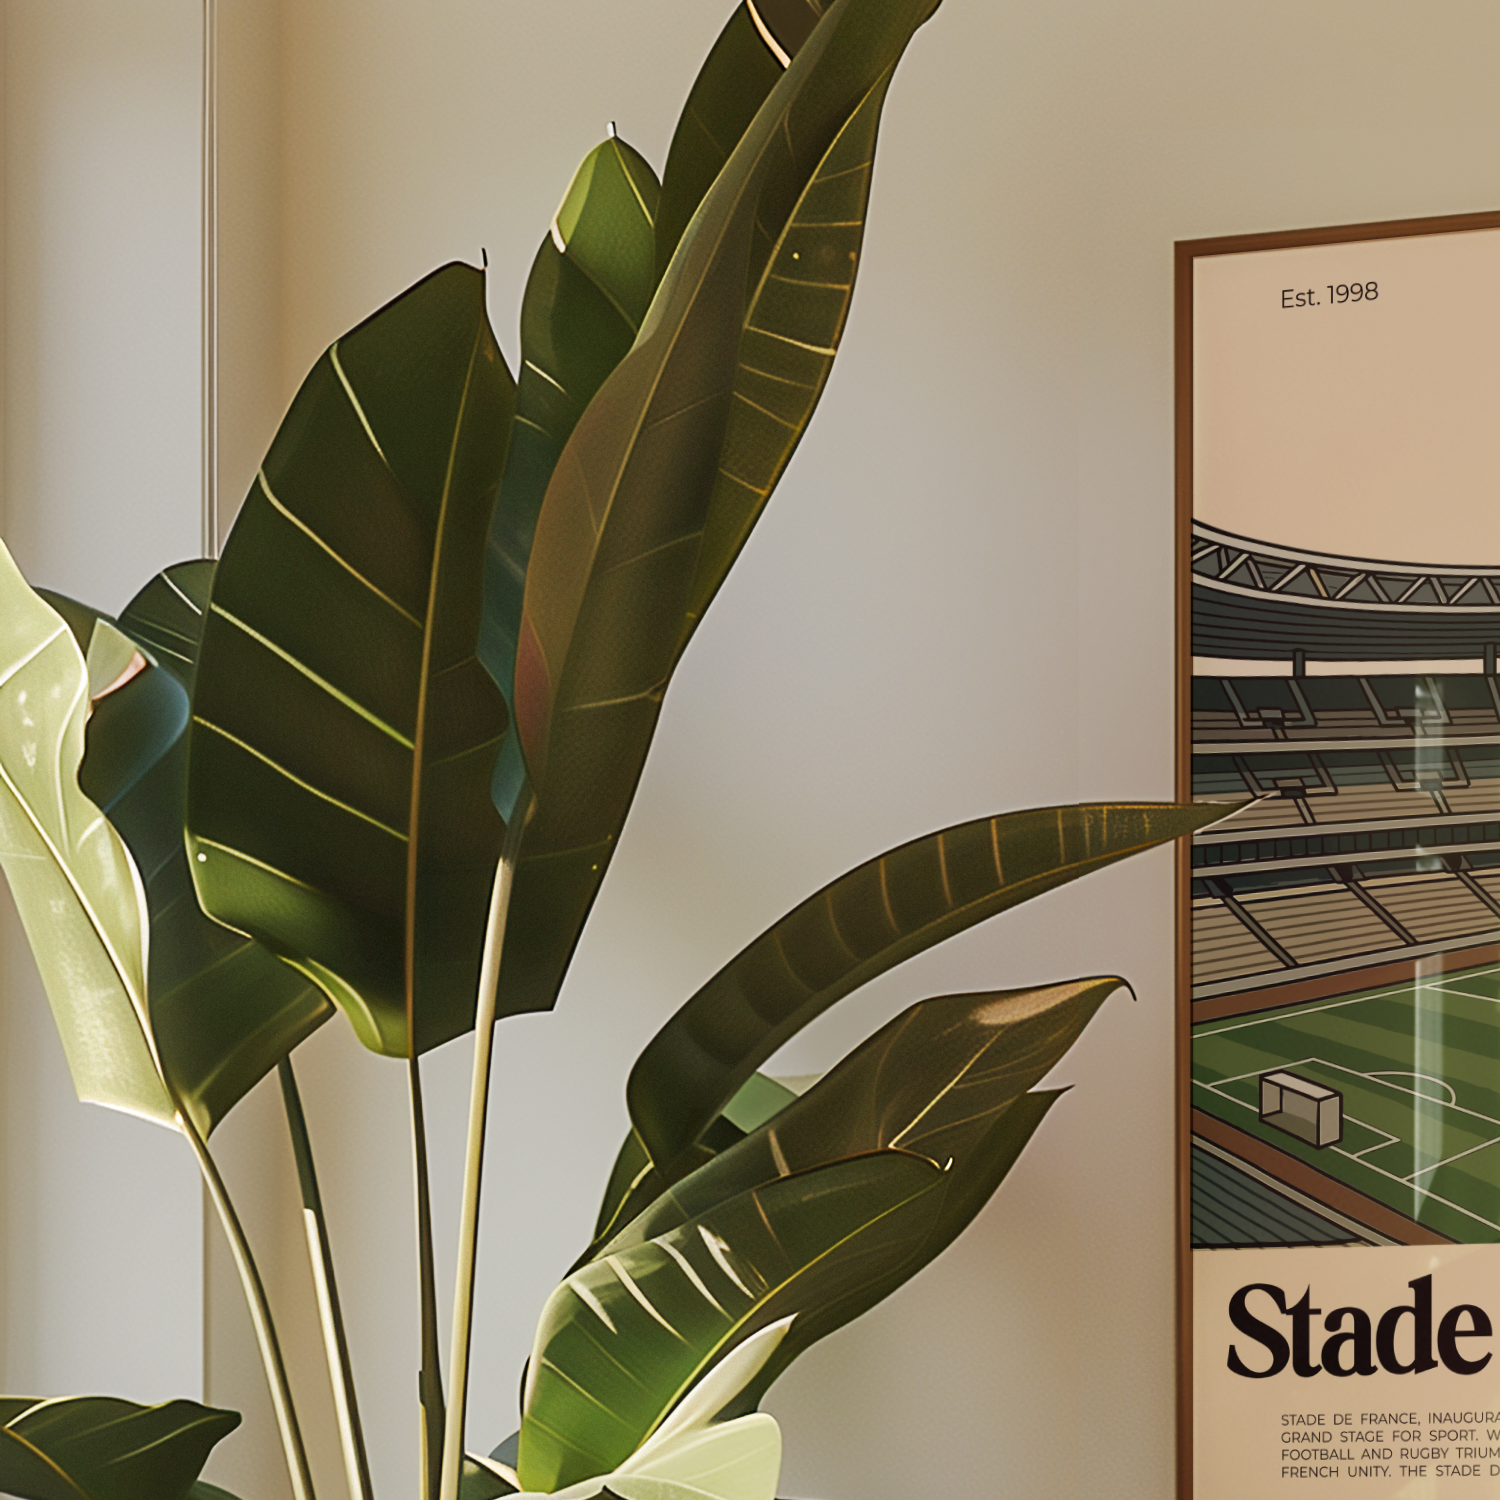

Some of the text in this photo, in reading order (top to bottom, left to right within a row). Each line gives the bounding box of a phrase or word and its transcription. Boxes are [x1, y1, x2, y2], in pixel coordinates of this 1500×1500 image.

[1282, 281, 1378, 308] Est. 1998
[1227, 1274, 1493, 1379] Stade
[1281, 1413, 1326, 1427] STADE
[1333, 1413, 1353, 1426] DE
[1360, 1412, 1421, 1426] FRANCE,
[1280, 1430, 1333, 1444] GRAND
[1339, 1430, 1384, 1443] STAGE
[1392, 1429, 1422, 1443] FOR
[1429, 1428, 1479, 1442] SPORT.
[1281, 1448, 1355, 1461] FOOTBALL
[1360, 1447, 1393, 1460] AND
[1400, 1446, 1450, 1460] RUGBY
[1281, 1465, 1339, 1479] FRENCH
[1347, 1465, 1392, 1478] UNITY.
[1398, 1464, 1427, 1478] THE
[1435, 1464, 1481, 1477] STADE
